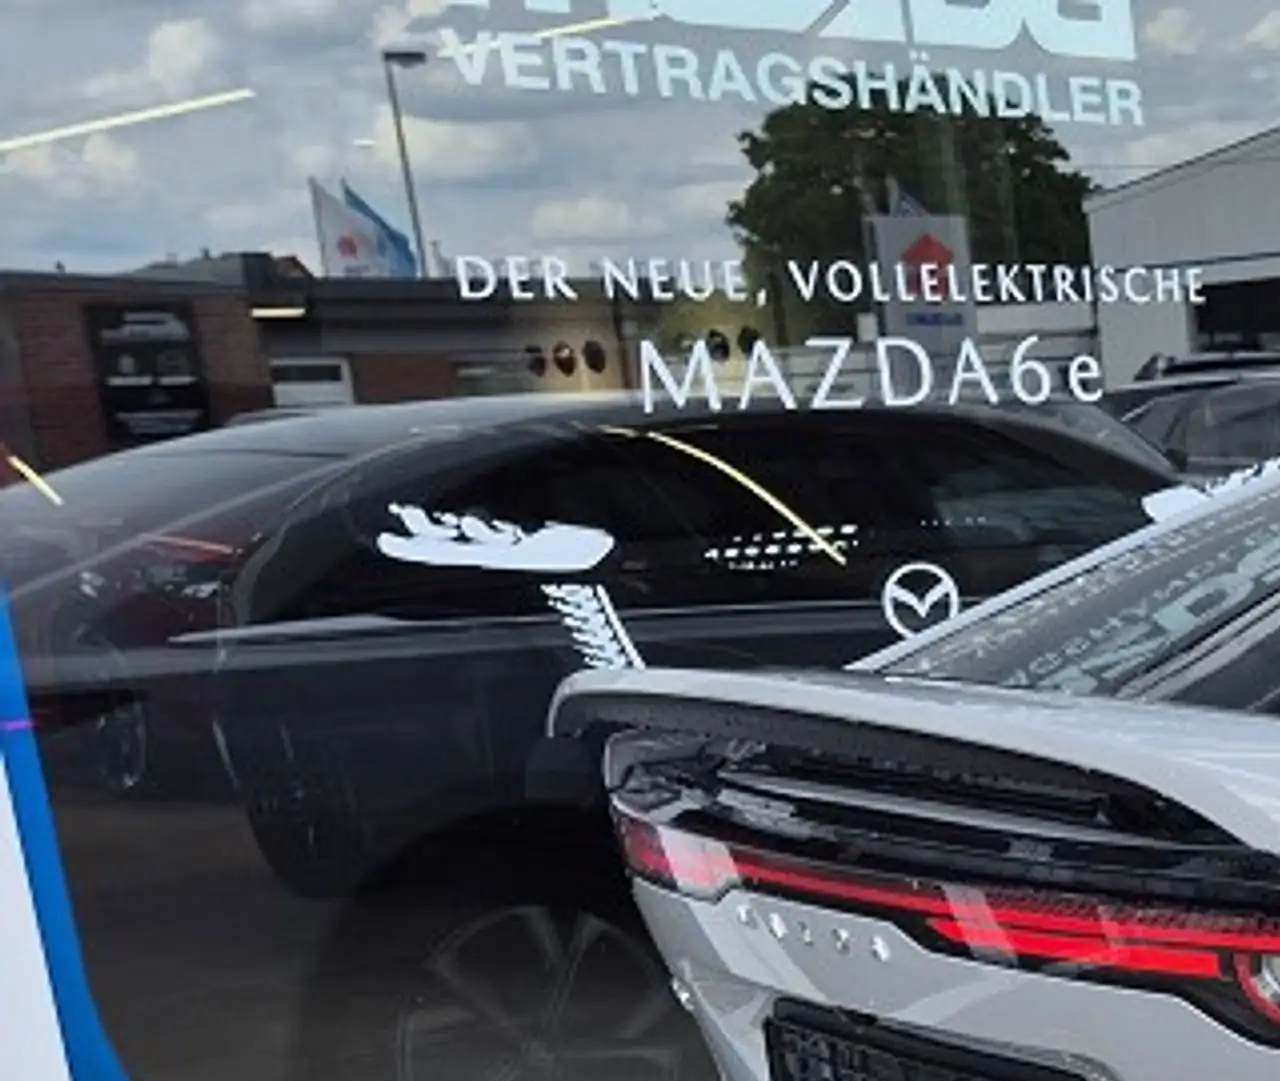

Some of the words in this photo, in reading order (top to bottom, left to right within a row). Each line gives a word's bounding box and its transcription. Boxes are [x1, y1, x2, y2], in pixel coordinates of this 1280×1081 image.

[438, 27, 1144, 127] VERTRAGSHÄNDLER
[457, 255, 576, 301] DER
[604, 257, 768, 307] NEUE,
[788, 259, 1207, 304] VOLLELEKTRISCHE
[639, 335, 1104, 414] MAZDA6e
